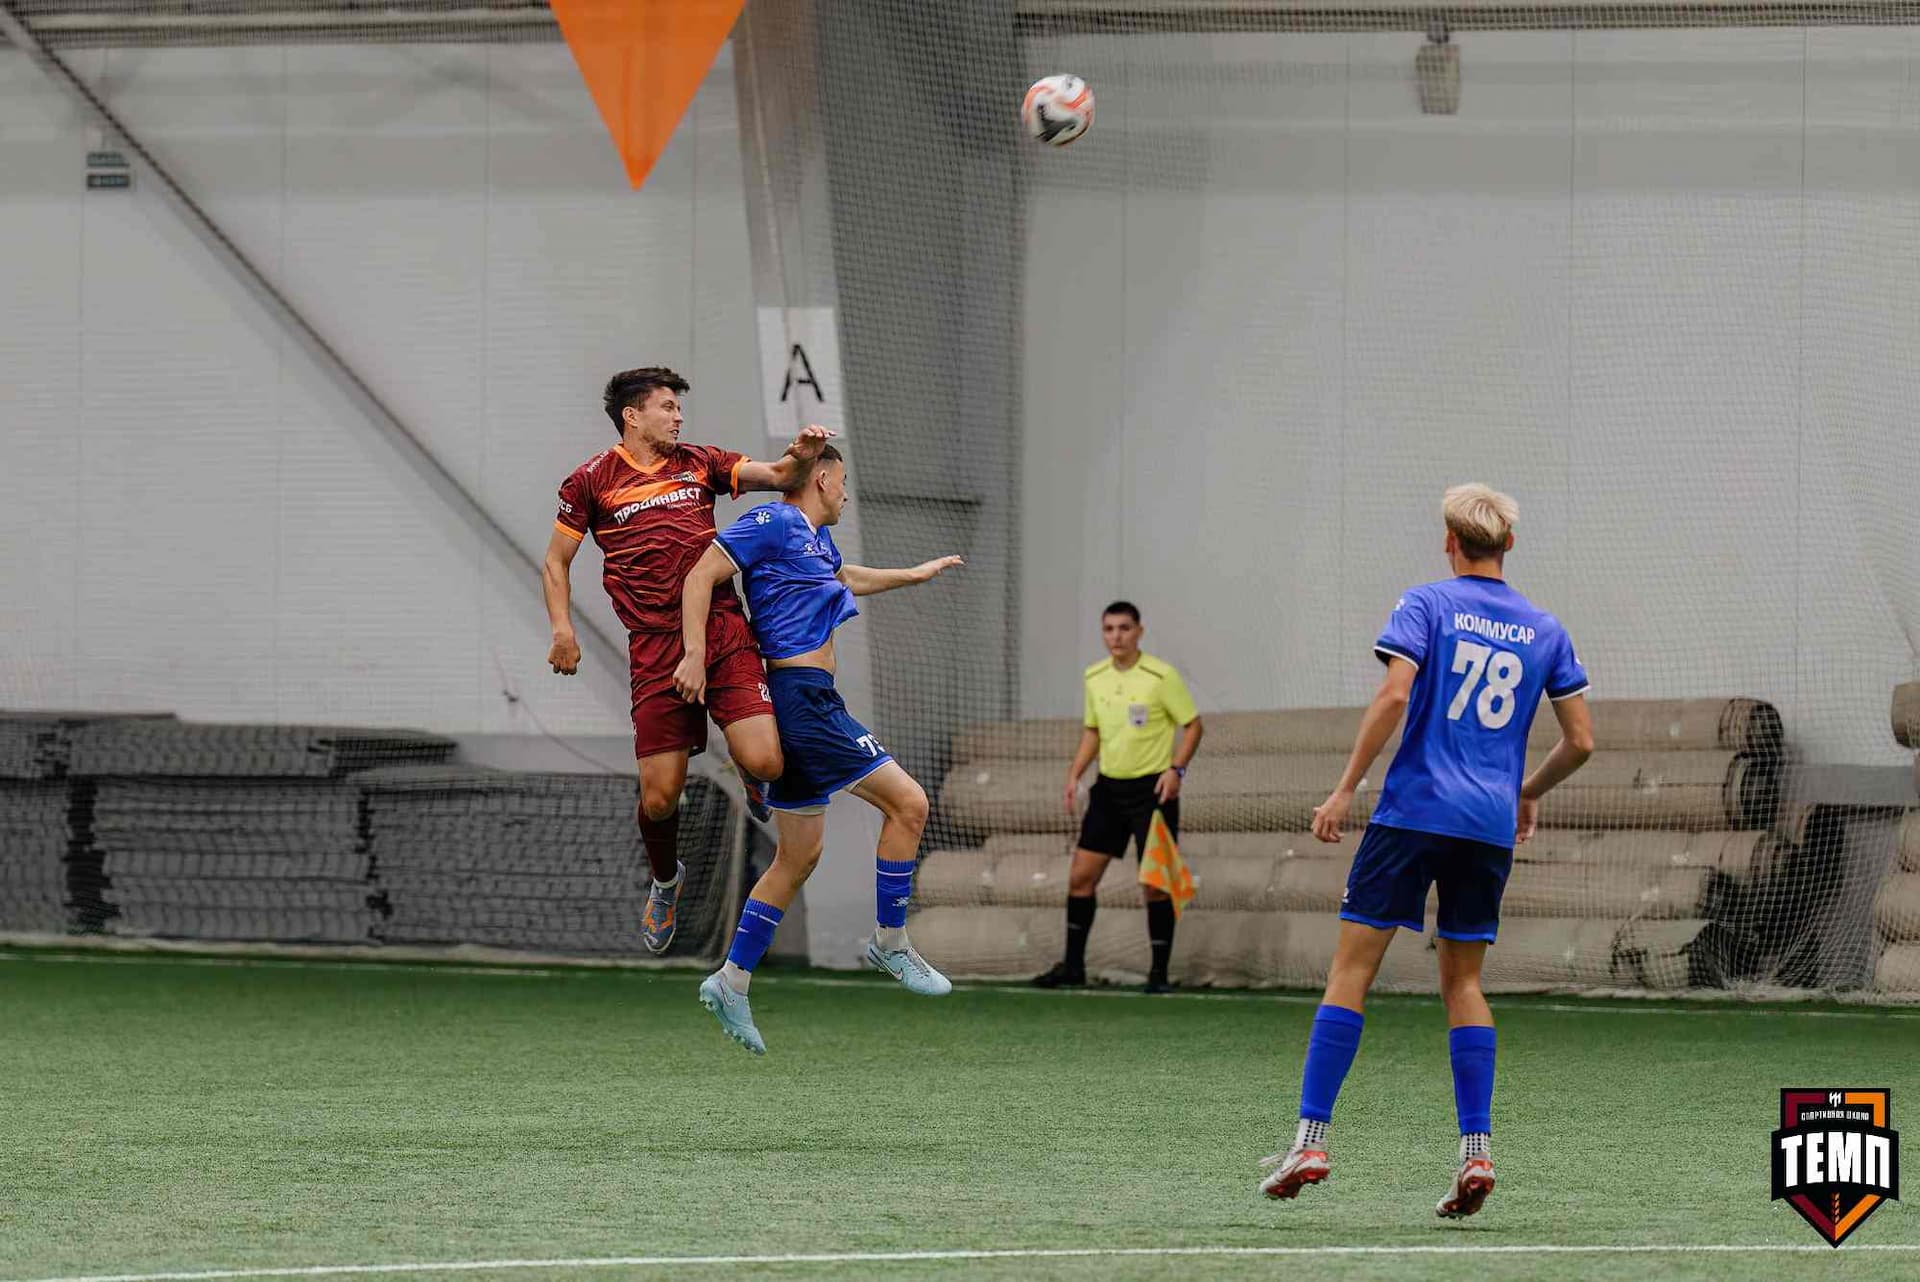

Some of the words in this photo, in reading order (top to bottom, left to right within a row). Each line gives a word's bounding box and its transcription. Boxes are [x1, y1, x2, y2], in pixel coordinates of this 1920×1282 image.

[614, 488, 701, 525] ПРОДИНВЕСТ
[1454, 613, 1535, 645] КОММУСАР
[1447, 640, 1523, 729] 78
